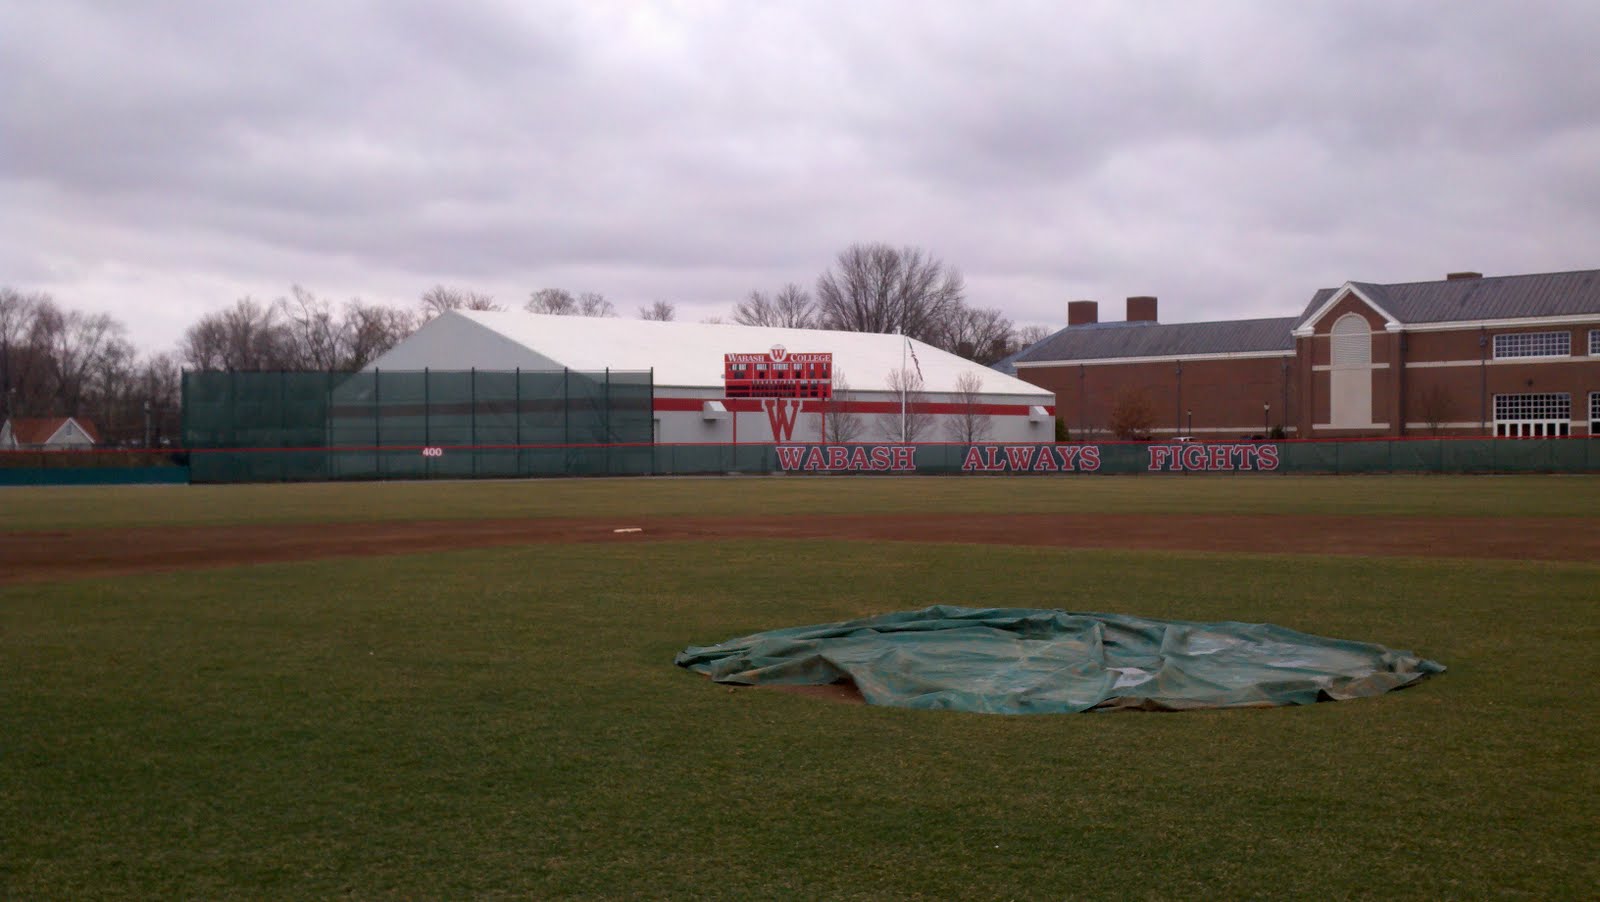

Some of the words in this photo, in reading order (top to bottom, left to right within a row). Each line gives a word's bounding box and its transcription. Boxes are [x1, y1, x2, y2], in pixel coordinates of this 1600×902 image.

[728, 353, 765, 362] WABASH
[790, 353, 831, 362] COLLEGE
[770, 348, 786, 360] W
[763, 399, 801, 441] W
[422, 447, 443, 456] 400
[776, 446, 916, 471] WABASH
[962, 446, 1100, 471] ALWAYS
[1148, 444, 1279, 471] FIGHTS
